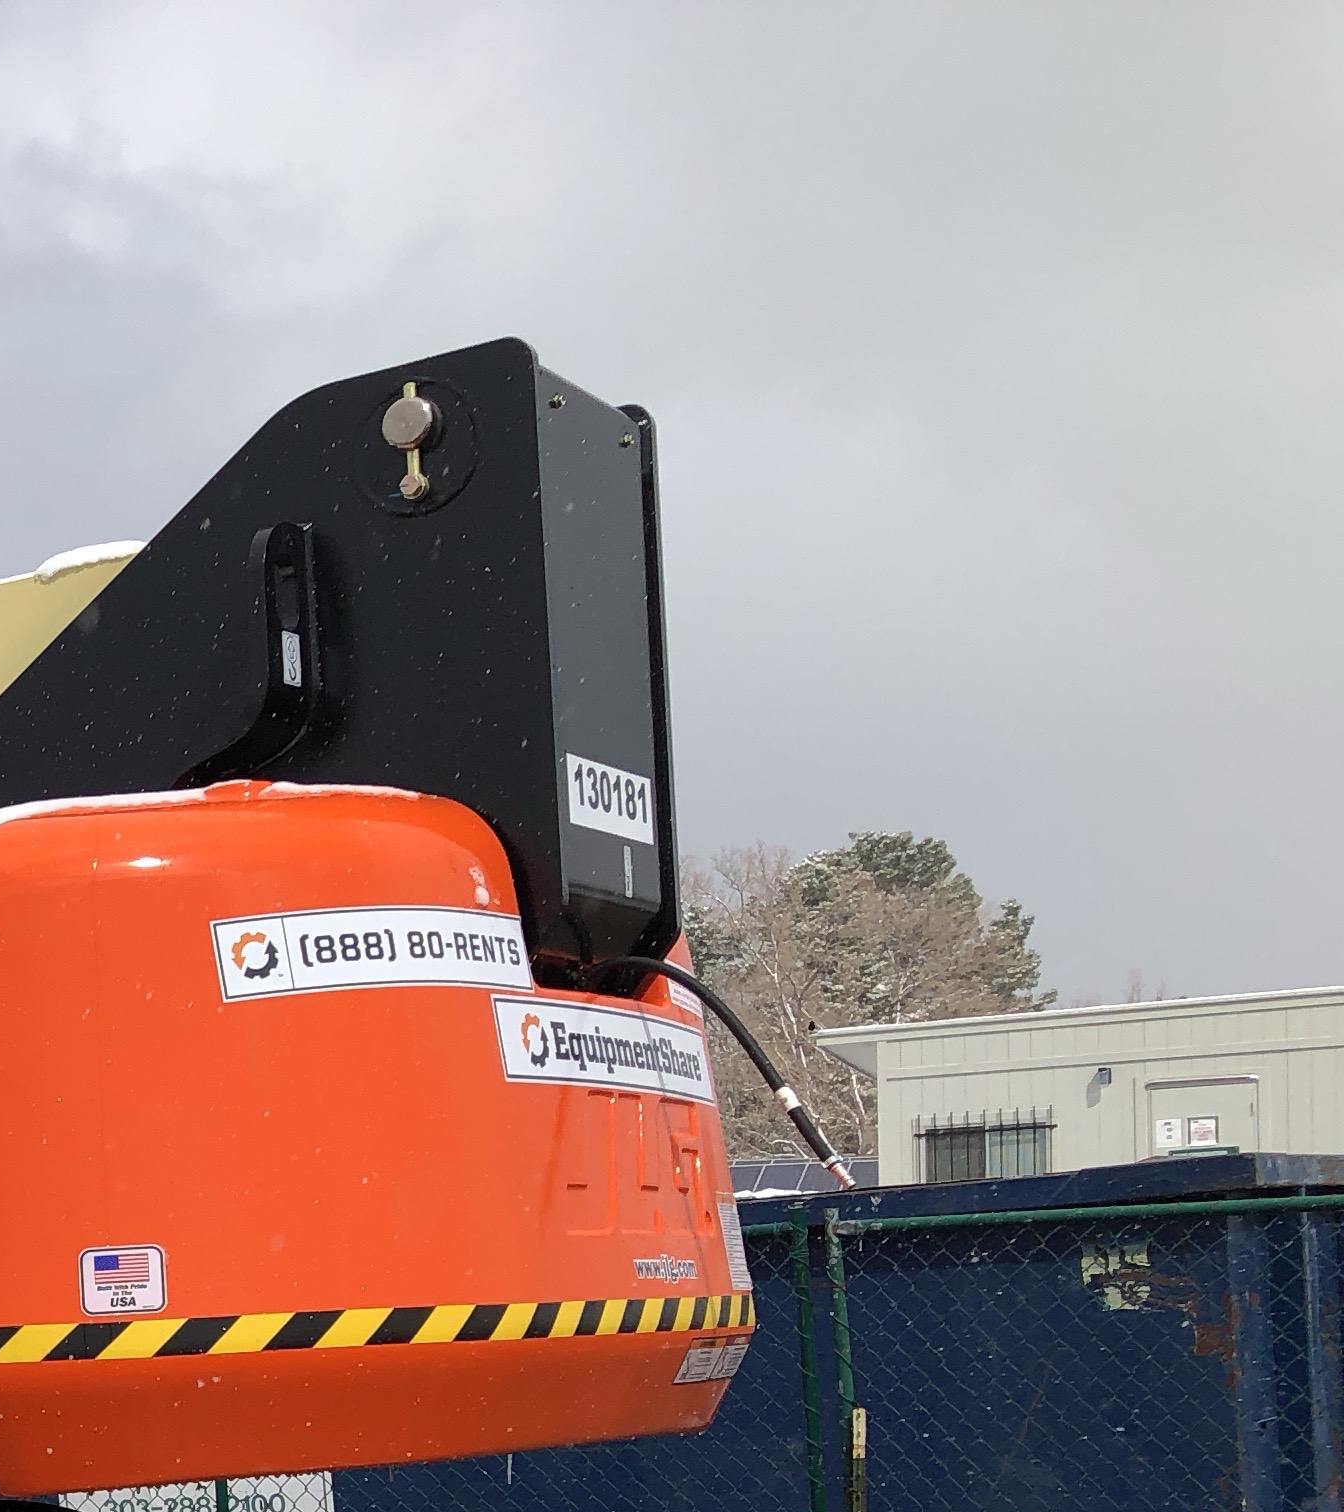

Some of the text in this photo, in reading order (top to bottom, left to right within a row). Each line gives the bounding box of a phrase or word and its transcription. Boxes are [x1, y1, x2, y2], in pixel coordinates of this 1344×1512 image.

[574, 763, 648, 824] 130181
[299, 929, 521, 968] (888) 80-RENTS
[550, 1020, 702, 1082] EquipmentShare
[634, 1254, 698, 1283] www.jlg.com
[110, 1297, 137, 1308] USA
